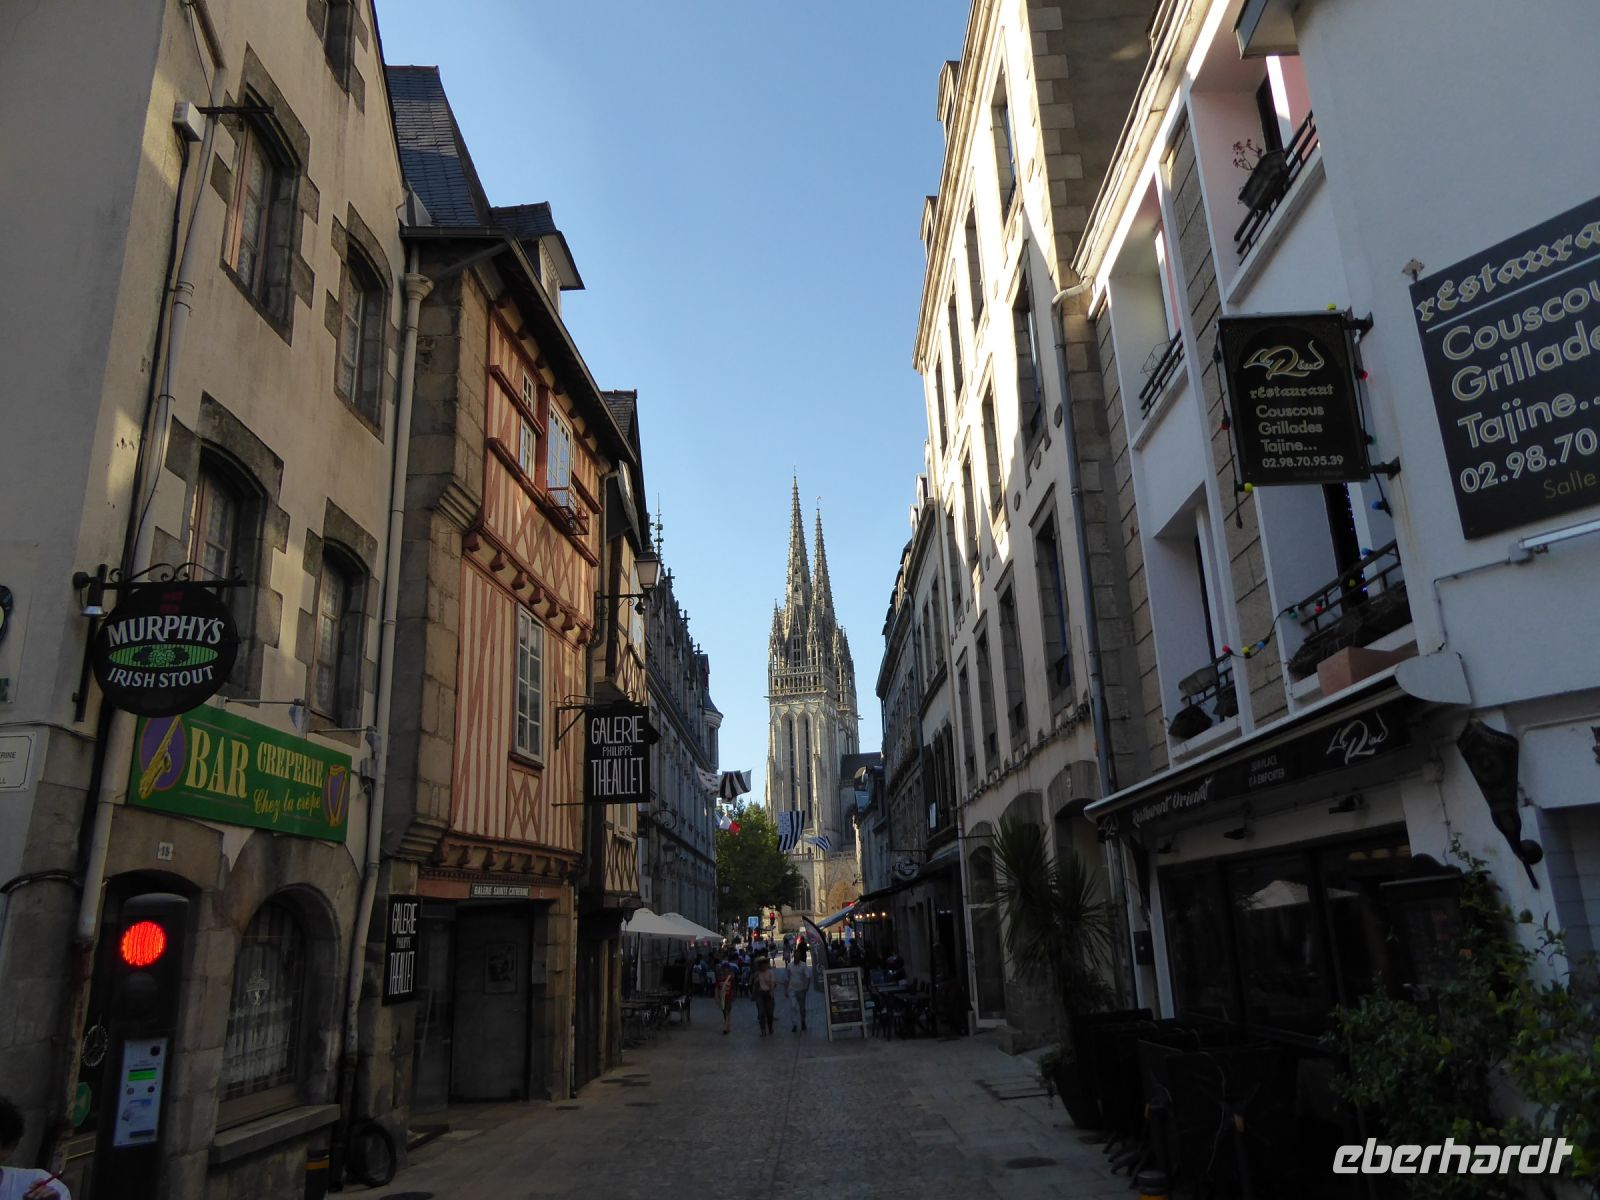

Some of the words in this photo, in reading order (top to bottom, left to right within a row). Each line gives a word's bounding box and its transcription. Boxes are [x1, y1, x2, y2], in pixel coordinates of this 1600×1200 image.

[1256, 405, 1325, 418] Couscous
[1258, 420, 1323, 435] Grillades
[1260, 439, 1318, 455] Tajine...
[1262, 455, 1344, 468] 02.98.70.95.39
[1543, 470, 1597, 499] Salle
[107, 615, 225, 648] MURPHY'S
[107, 667, 155, 688] IRISH
[158, 665, 215, 688] STOUT
[591, 715, 644, 744] GALERIE
[185, 727, 248, 798] BAR
[602, 745, 633, 757] PHILIPPE
[591, 757, 644, 796] THEALLET
[391, 902, 418, 935] GALERIE
[389, 951, 415, 996] THEALLET
